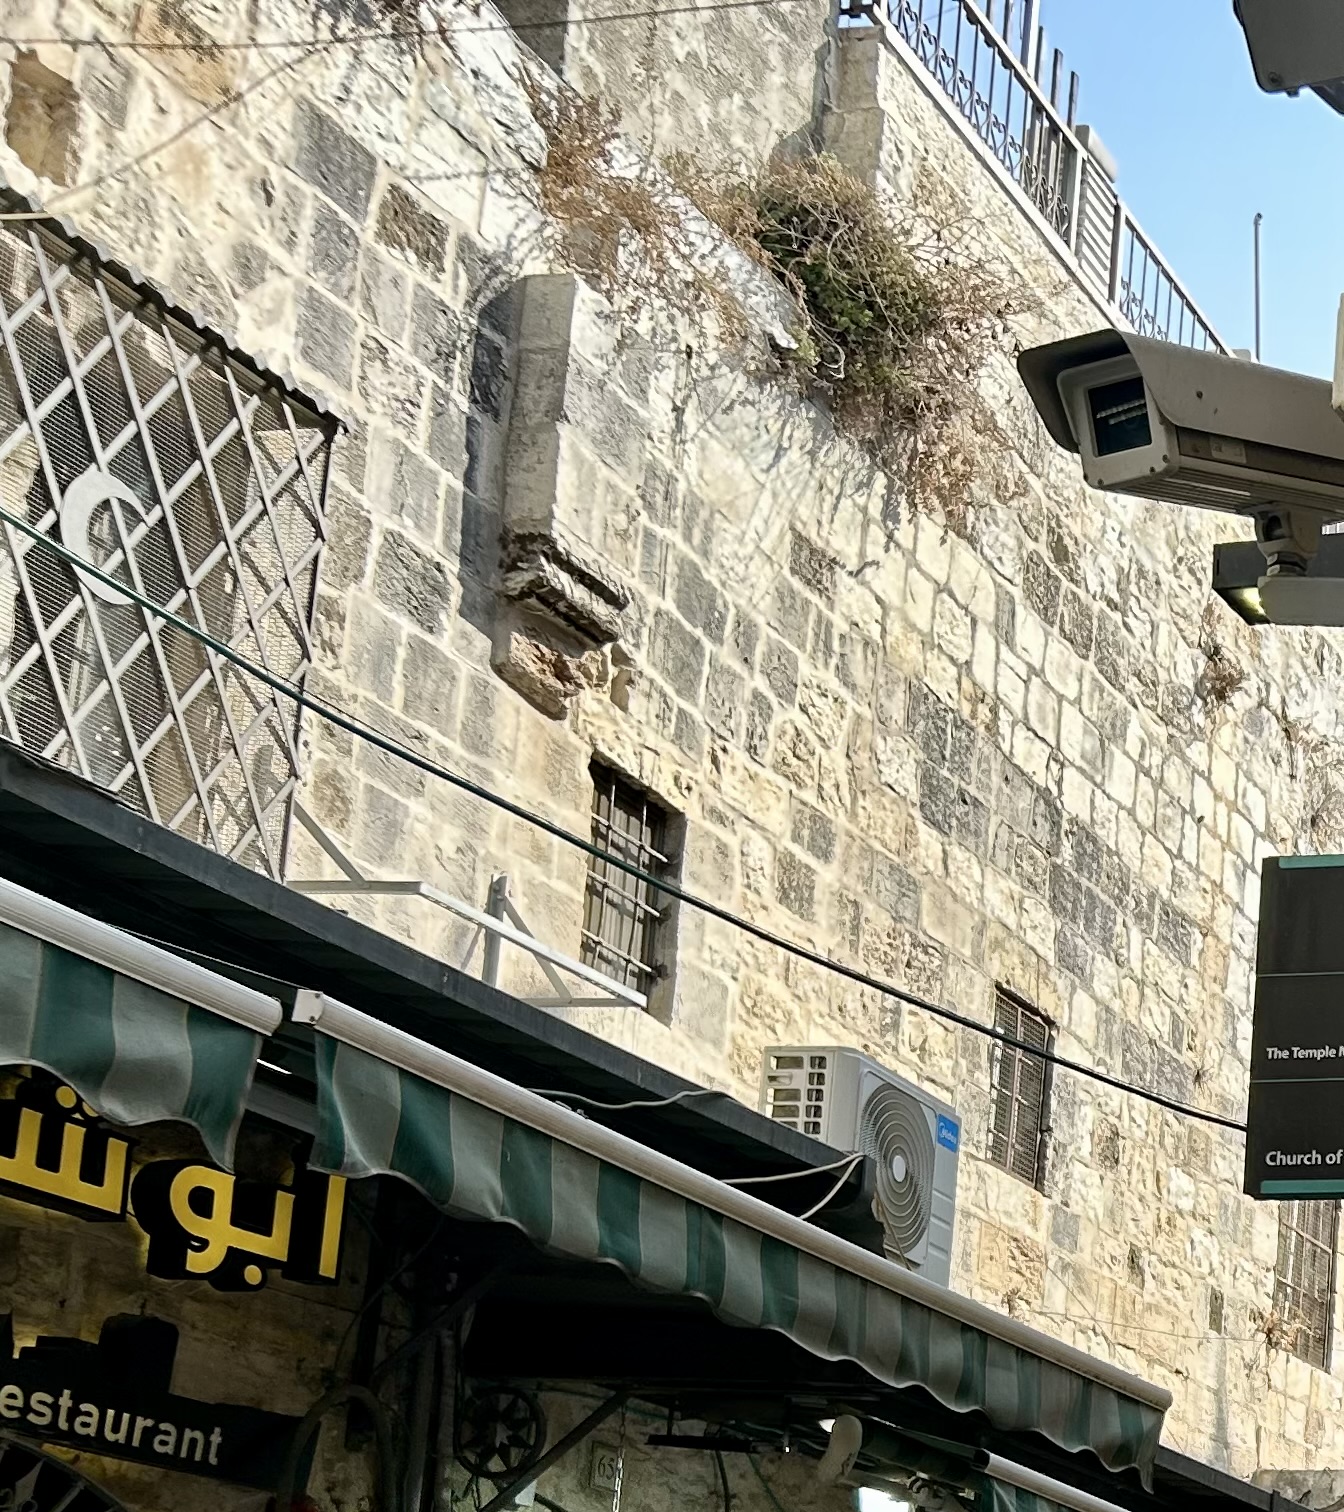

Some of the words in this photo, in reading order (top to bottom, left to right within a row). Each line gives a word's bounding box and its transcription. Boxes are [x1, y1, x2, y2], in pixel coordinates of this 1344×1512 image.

[1266, 1046, 1290, 1060] The
[1291, 1044, 1337, 1061] Temple
[1265, 1150, 1322, 1166] Church
[1325, 1148, 1344, 1165] of
[0, 1384, 224, 1466] estaurant
